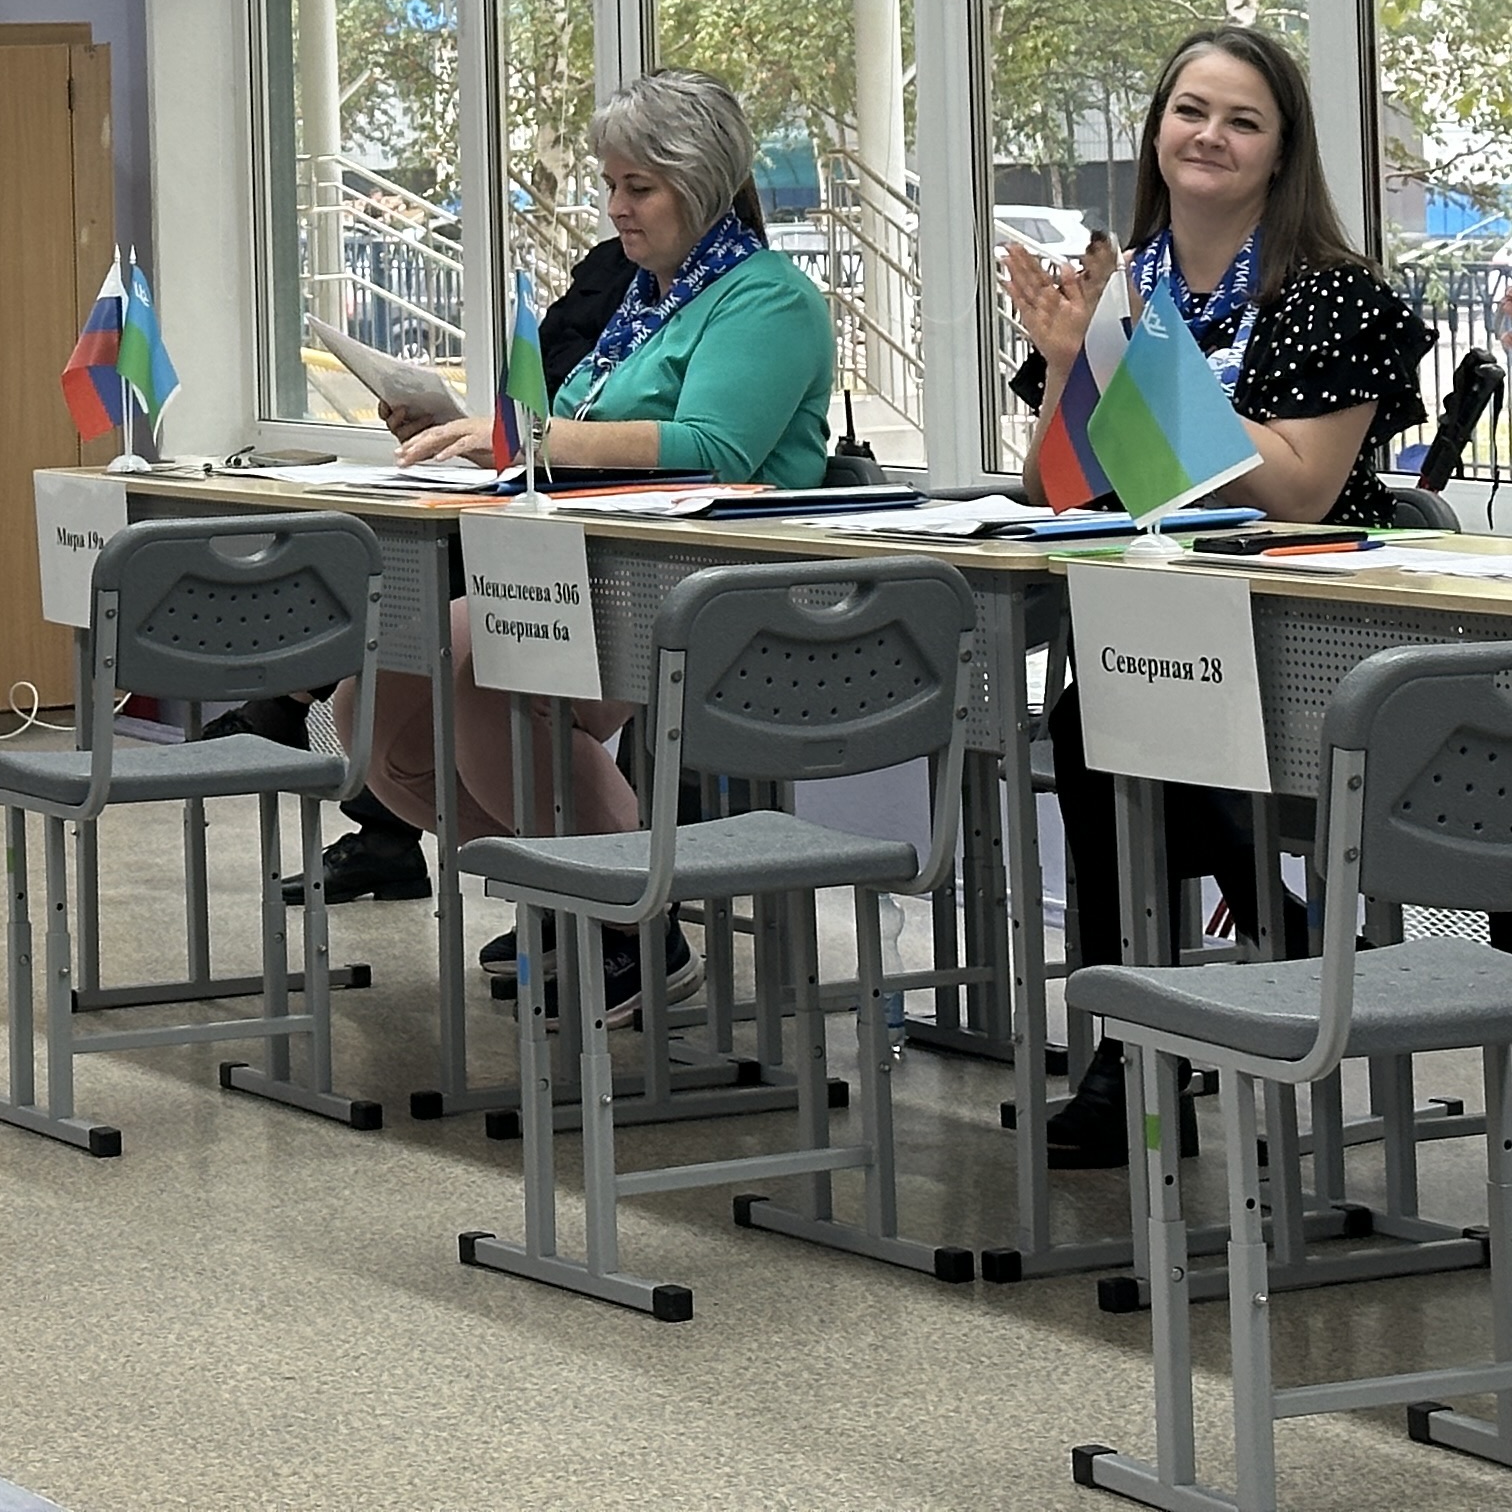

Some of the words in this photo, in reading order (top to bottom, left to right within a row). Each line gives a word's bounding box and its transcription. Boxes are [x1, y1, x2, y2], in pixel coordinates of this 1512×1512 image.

[682, 260, 710, 287] УИК
[1232, 259, 1250, 293] УИК
[652, 292, 681, 320] УИК
[1239, 306, 1260, 330] ИК
[627, 326, 651, 351] УИК
[56, 526, 85, 552] Мира
[88, 531, 104, 550] 19а
[472, 574, 551, 603] Менделеева
[485, 612, 550, 643] Северная
[552, 619, 570, 641] 6а
[1101, 646, 1195, 684] Северная
[1199, 656, 1224, 684] 28
